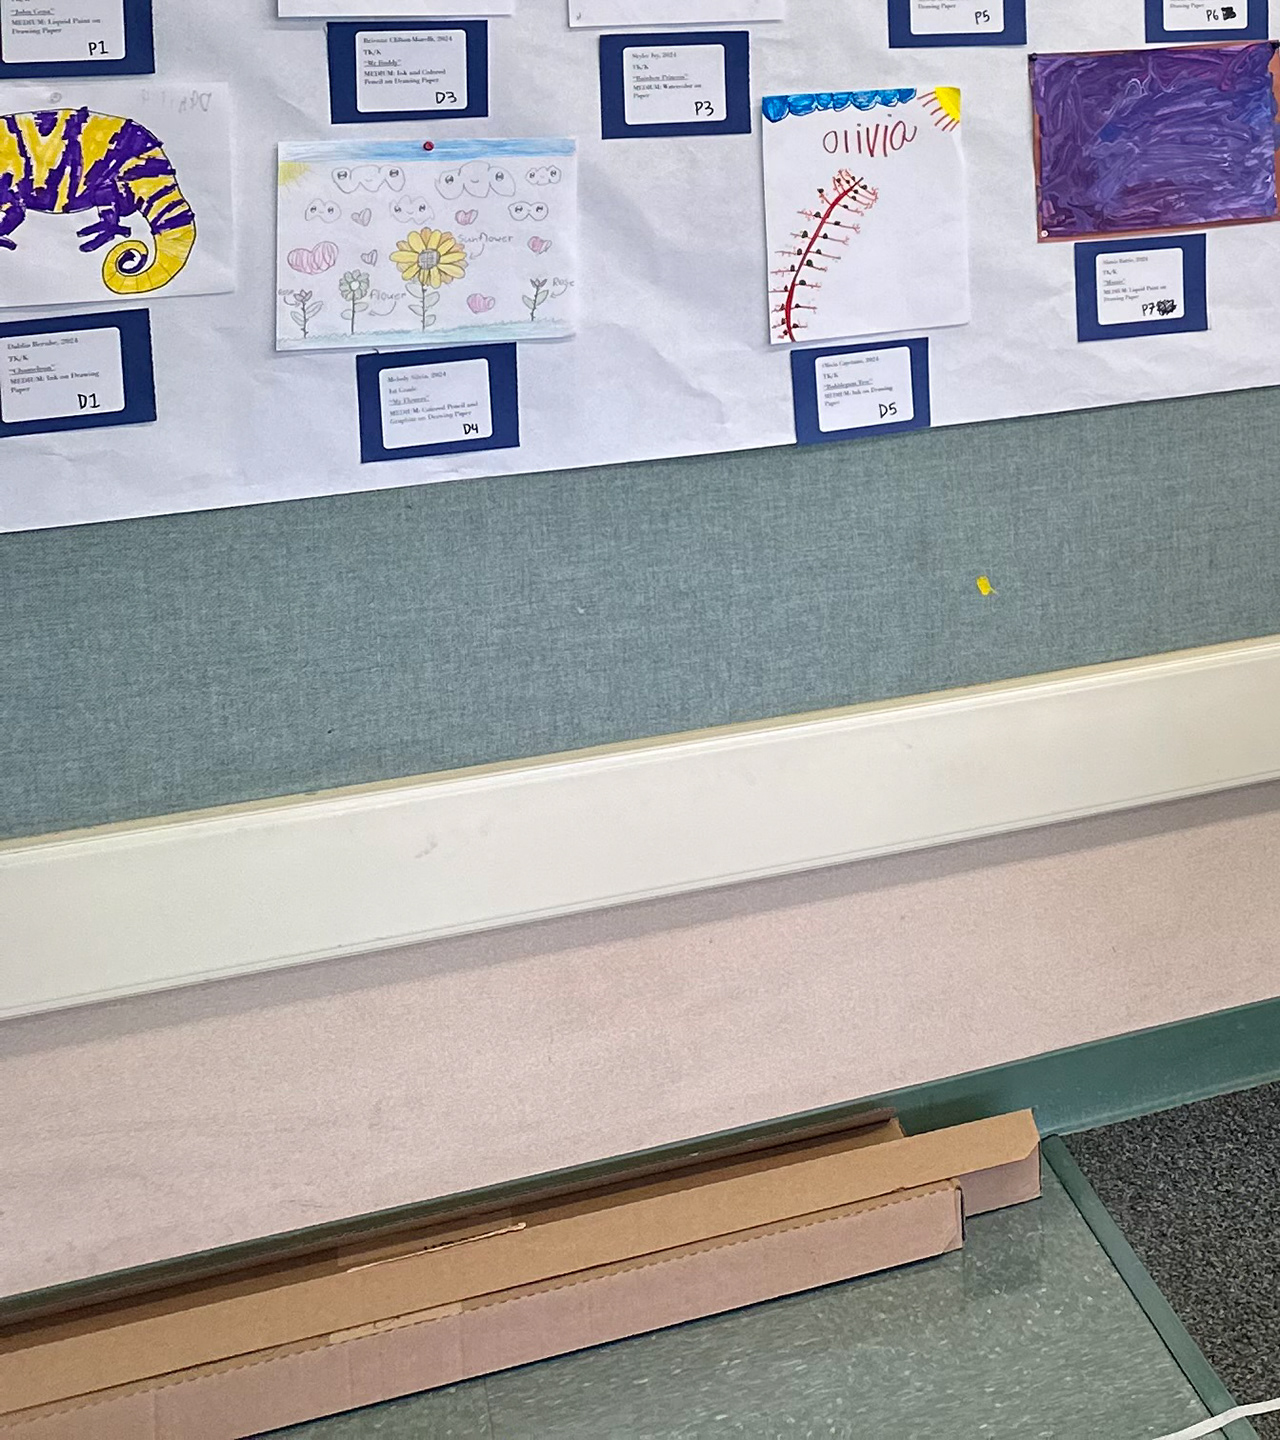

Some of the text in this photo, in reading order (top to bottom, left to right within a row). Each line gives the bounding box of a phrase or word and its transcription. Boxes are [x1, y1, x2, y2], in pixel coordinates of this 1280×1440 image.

[975, 10, 990, 25] P5
[1206, 10, 1219, 21] P6
[88, 41, 108, 55] P1
[436, 92, 457, 104] D3
[695, 101, 714, 116] P3
[1142, 302, 1155, 316] P7
[78, 393, 100, 409] D1
[428, 412, 453, 420] Drawing
[879, 402, 897, 418] D5
[463, 424, 478, 434] D4
